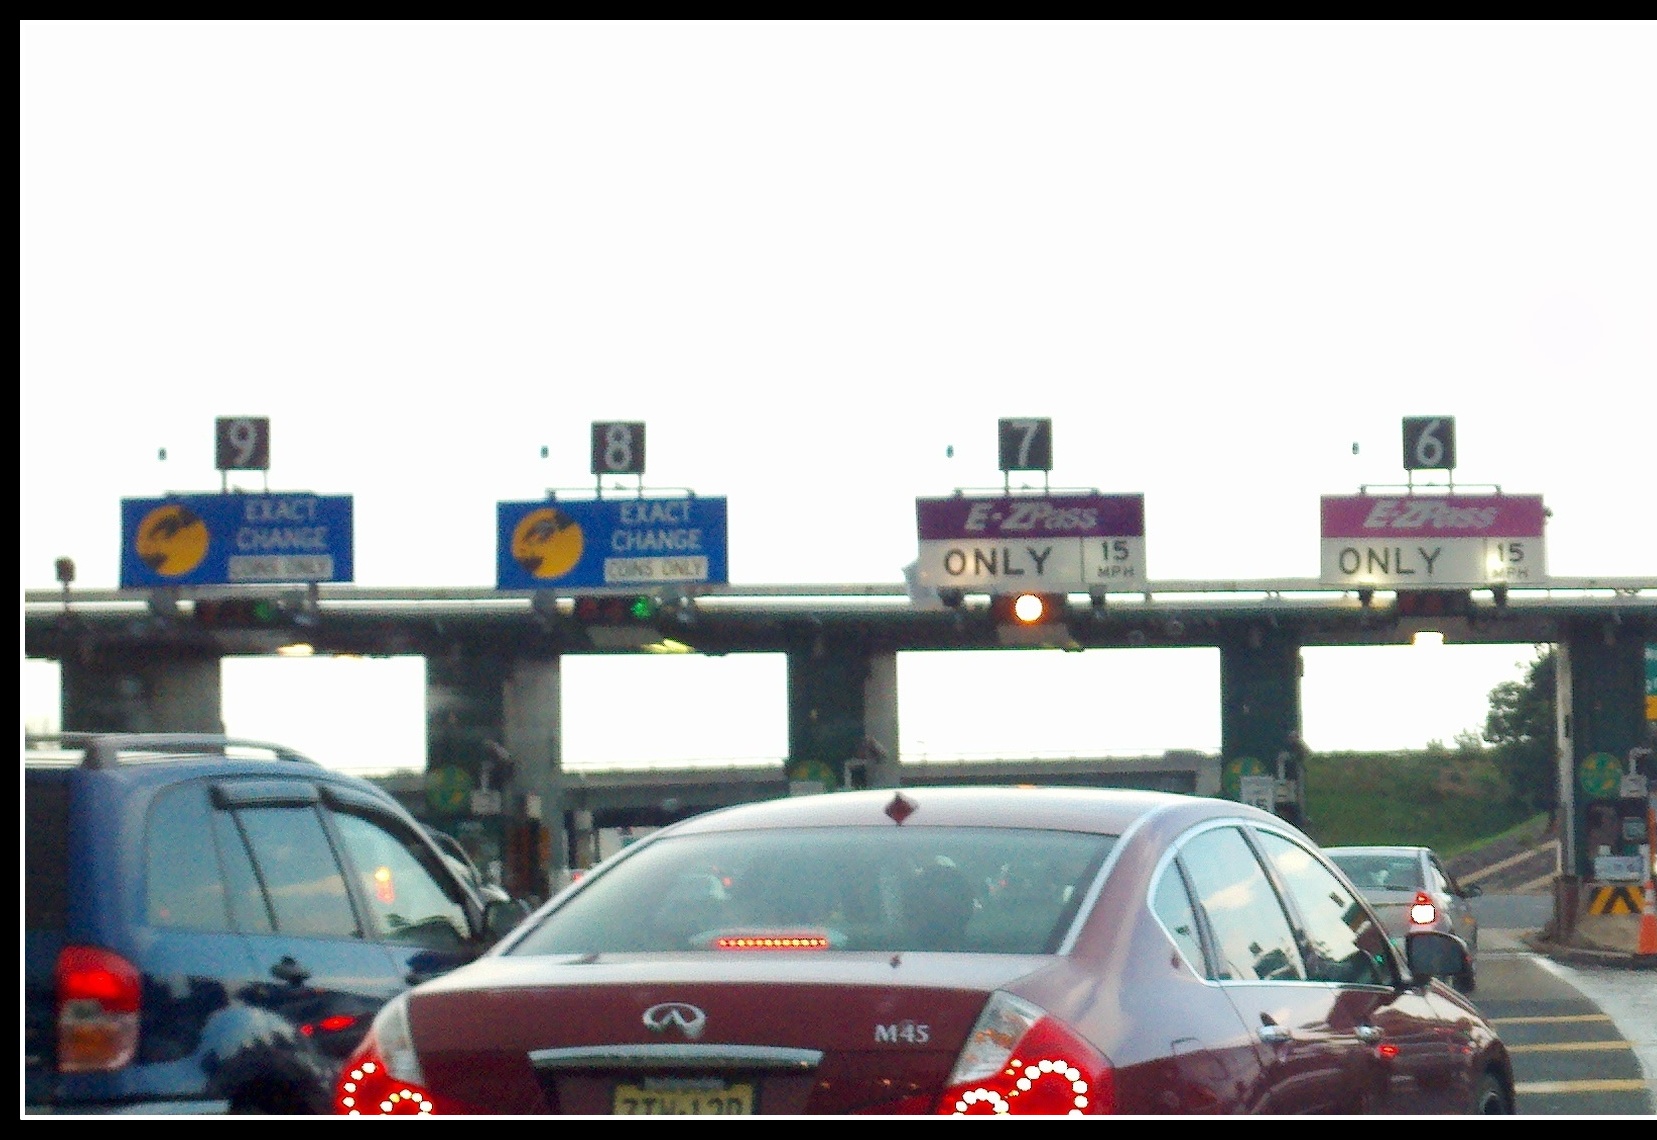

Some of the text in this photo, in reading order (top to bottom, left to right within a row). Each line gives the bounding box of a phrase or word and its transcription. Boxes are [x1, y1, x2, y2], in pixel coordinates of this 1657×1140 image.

[228, 420, 257, 467] 9
[604, 424, 632, 470] 8
[1012, 419, 1038, 467] 7
[1416, 419, 1445, 466] 6
[620, 502, 691, 524] EXACT
[964, 503, 1098, 531] E-ZPass
[611, 529, 701, 551] CHANGE
[944, 540, 1129, 576] ONLY 15
[1098, 565, 1134, 578] MPH
[1338, 542, 1525, 575] ONLY 15
[874, 1024, 929, 1043] M45
